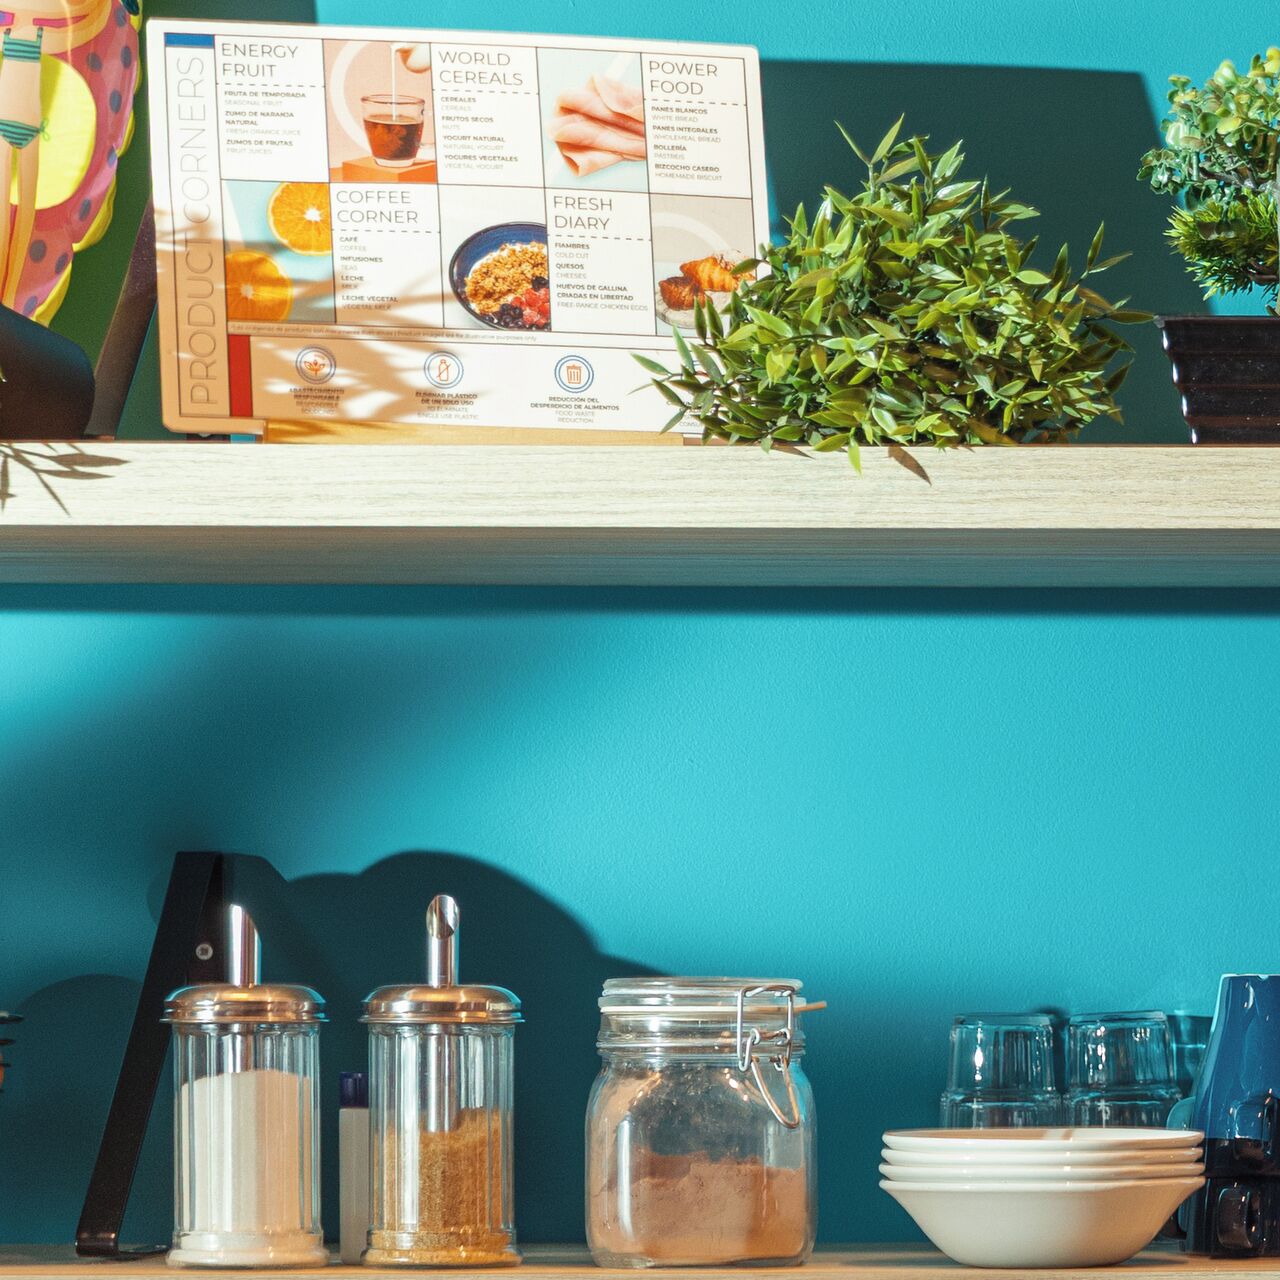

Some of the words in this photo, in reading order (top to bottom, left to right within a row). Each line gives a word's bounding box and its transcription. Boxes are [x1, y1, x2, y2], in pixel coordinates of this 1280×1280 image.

[221, 42, 298, 58] ENERGY
[438, 51, 511, 66] WORLD
[222, 63, 277, 78] FRUIT
[648, 60, 718, 77] POWER
[440, 70, 524, 86] CEREALS
[650, 80, 704, 96] FOOD
[676, 126, 718, 134] INTEGRALES
[176, 57, 211, 223] CORNERS
[336, 190, 412, 204] COFFEE
[554, 196, 613, 211] FRESH
[337, 210, 418, 224] CORNER
[554, 215, 610, 230] DIARY
[554, 242, 590, 250] FIAMBRES
[184, 230, 217, 404] PRODUCT
[530, 402, 572, 410] DESPERDICIO
